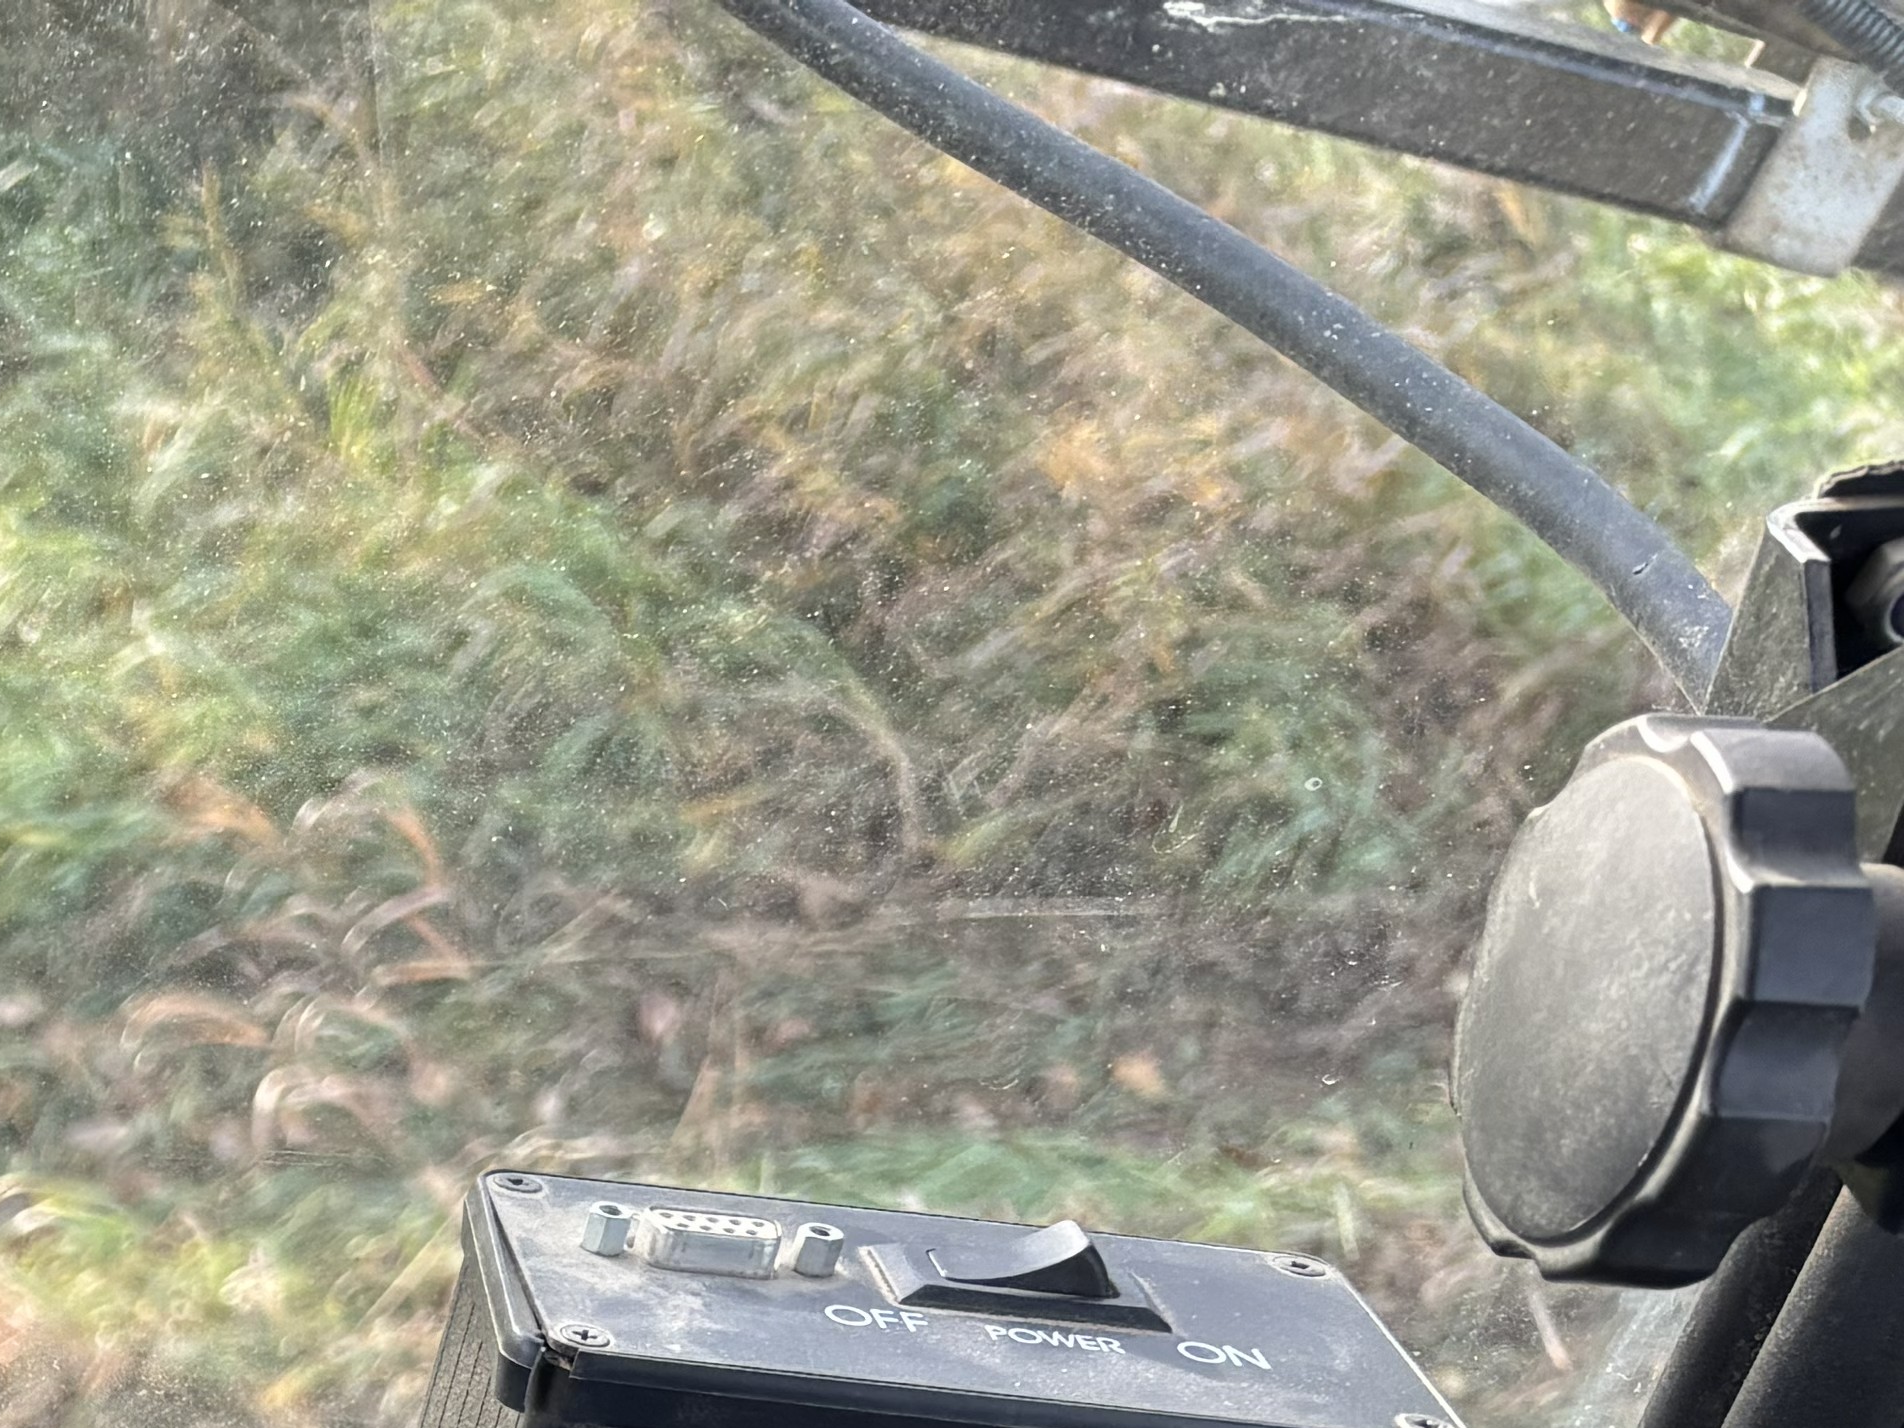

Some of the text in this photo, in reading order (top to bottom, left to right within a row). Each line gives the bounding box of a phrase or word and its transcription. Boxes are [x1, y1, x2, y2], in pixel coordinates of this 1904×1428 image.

[824, 1304, 928, 1333] OFF
[986, 1325, 1126, 1354] POWER
[1178, 1341, 1272, 1369] ON
